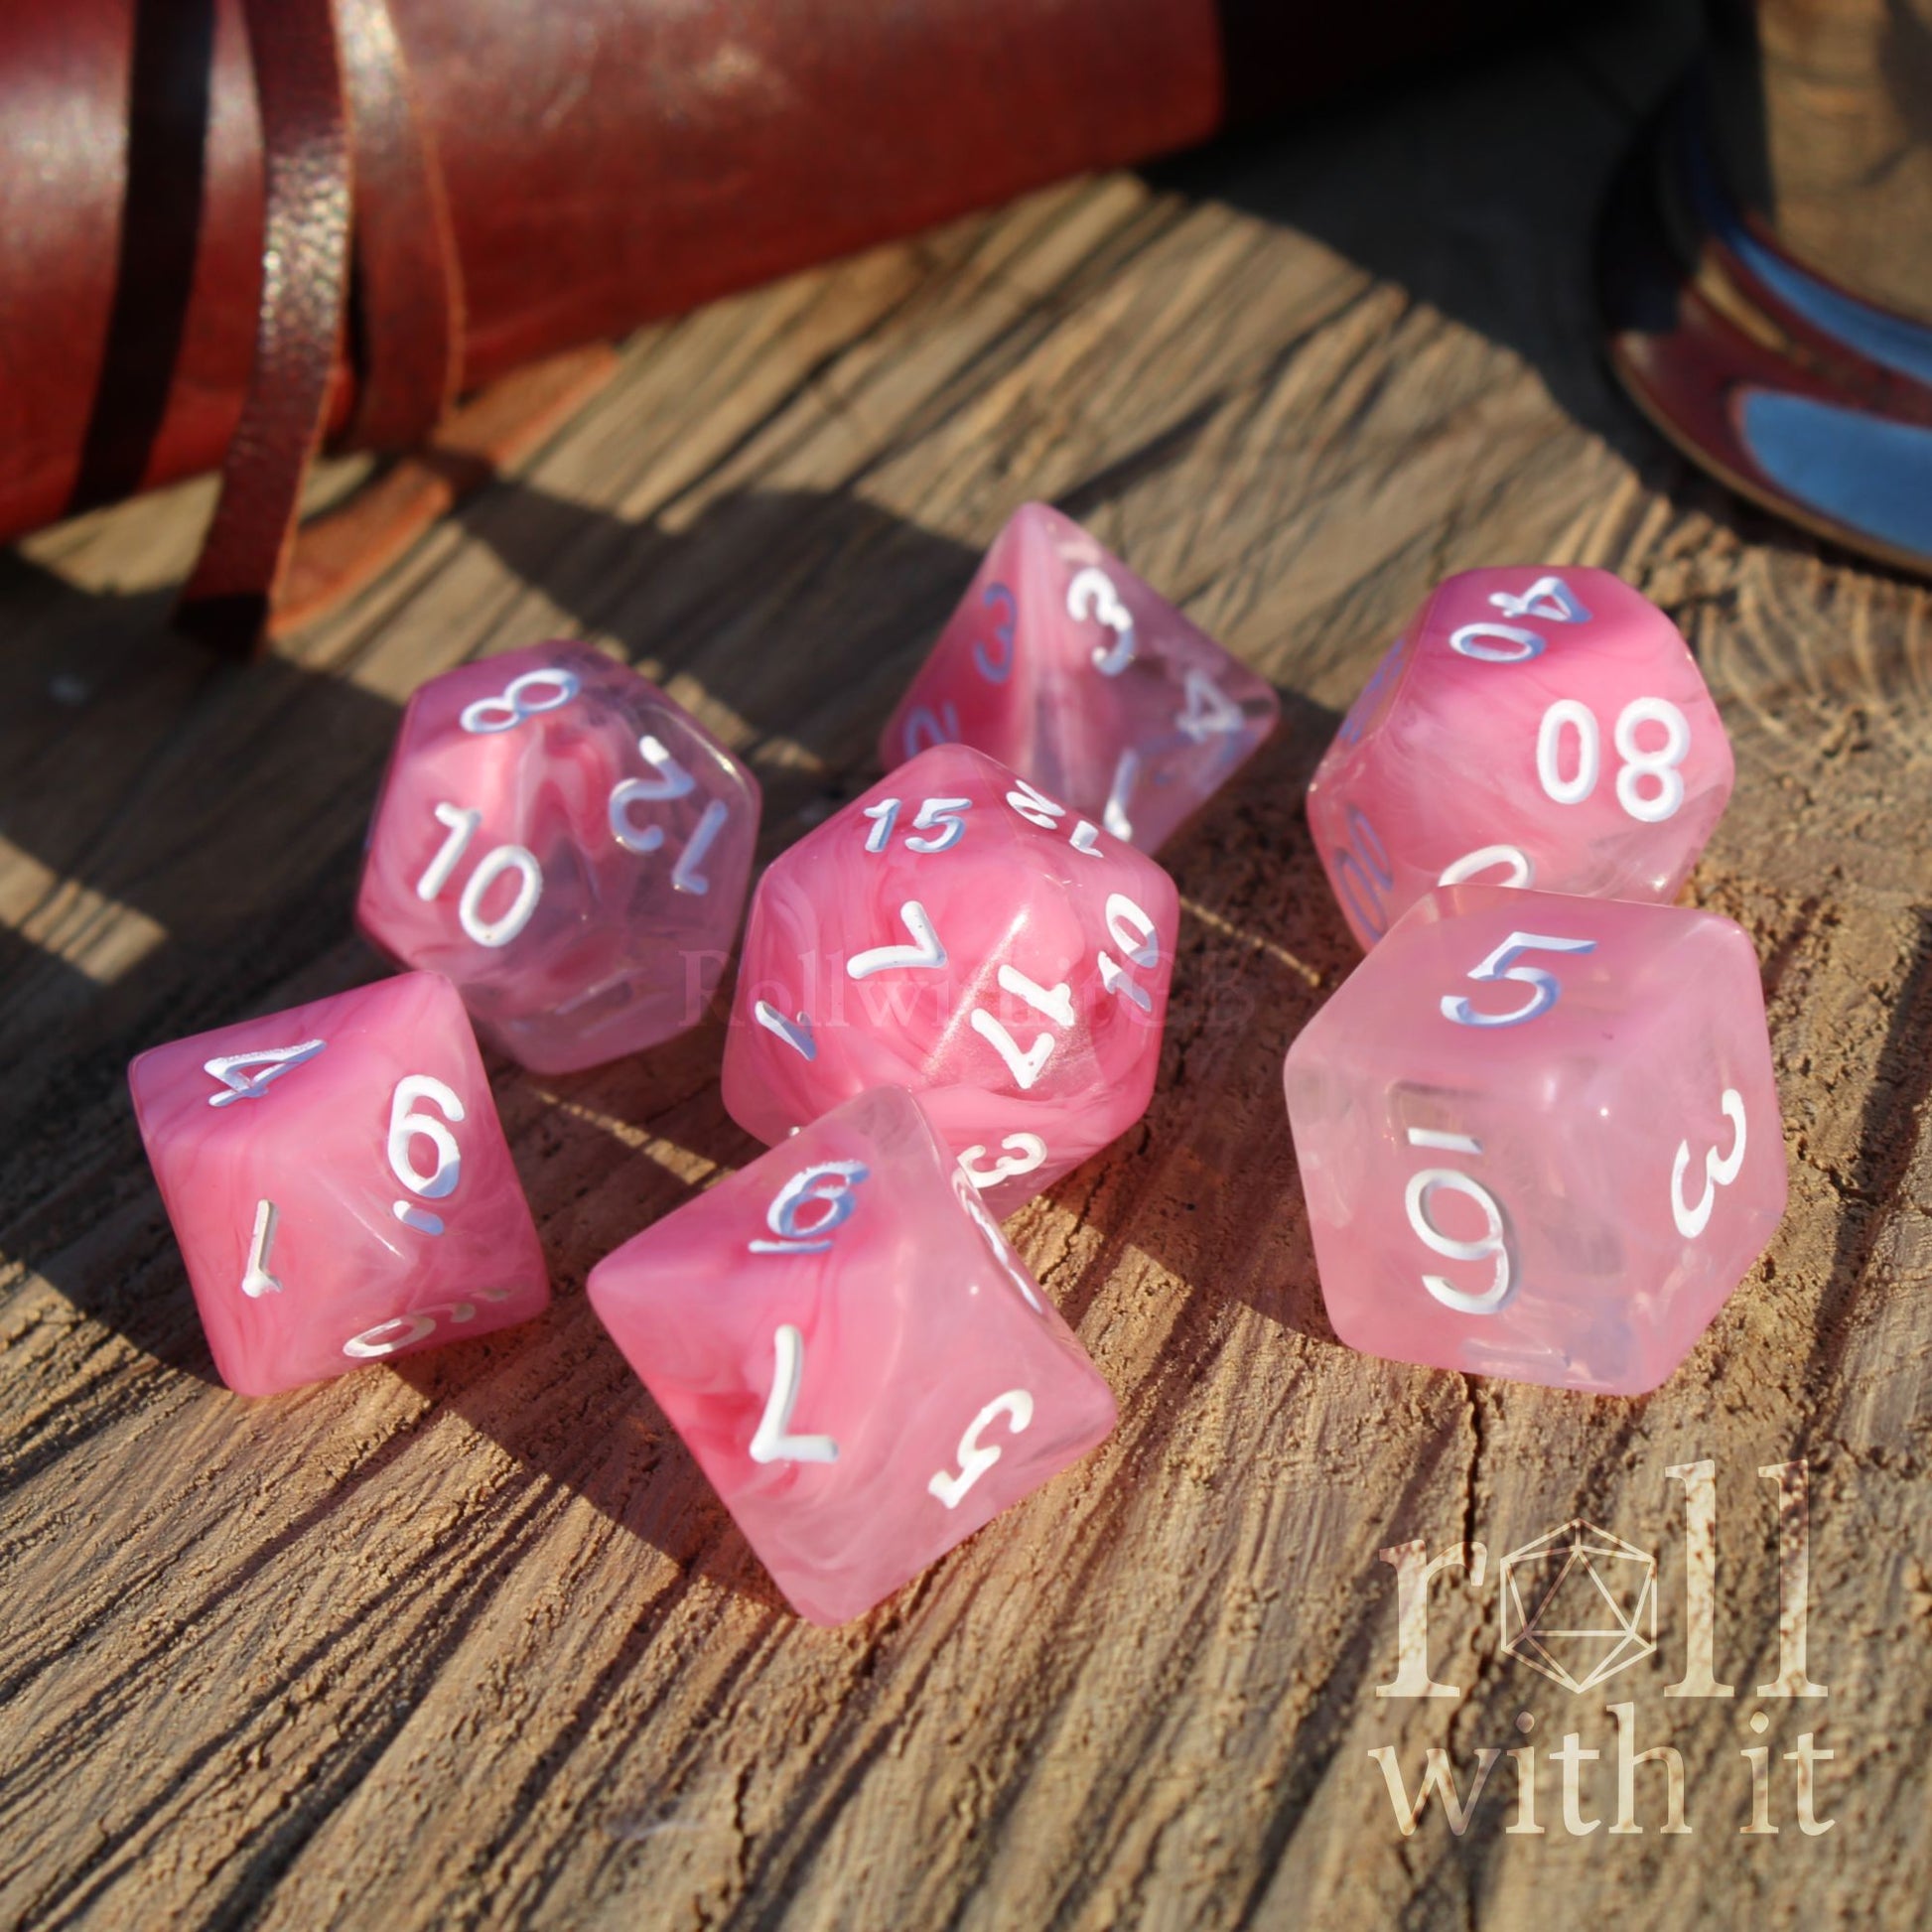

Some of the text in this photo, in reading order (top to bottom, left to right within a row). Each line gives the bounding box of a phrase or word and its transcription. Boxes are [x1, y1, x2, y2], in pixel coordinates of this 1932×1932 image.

[973, 582, 1019, 684] 3
[1067, 568, 1136, 675] 3
[460, 668, 581, 734] 8
[1175, 669, 1247, 744] 4
[417, 800, 543, 947] 10
[864, 797, 972, 853] 15
[846, 900, 947, 980] 7
[1097, 893, 1159, 1013] 10
[1441, 931, 1597, 1028] 5
[204, 1038, 328, 1107] 4
[971, 964, 1076, 1090] 17
[386, 1074, 465, 1236] 6
[957, 1131, 1048, 1189] 3
[1670, 1088, 1747, 1239] 3
[241, 1198, 284, 1299] 1
[748, 1159, 871, 1254] 6
[749, 1324, 838, 1463] 7
[926, 1389, 1035, 1510] 5
